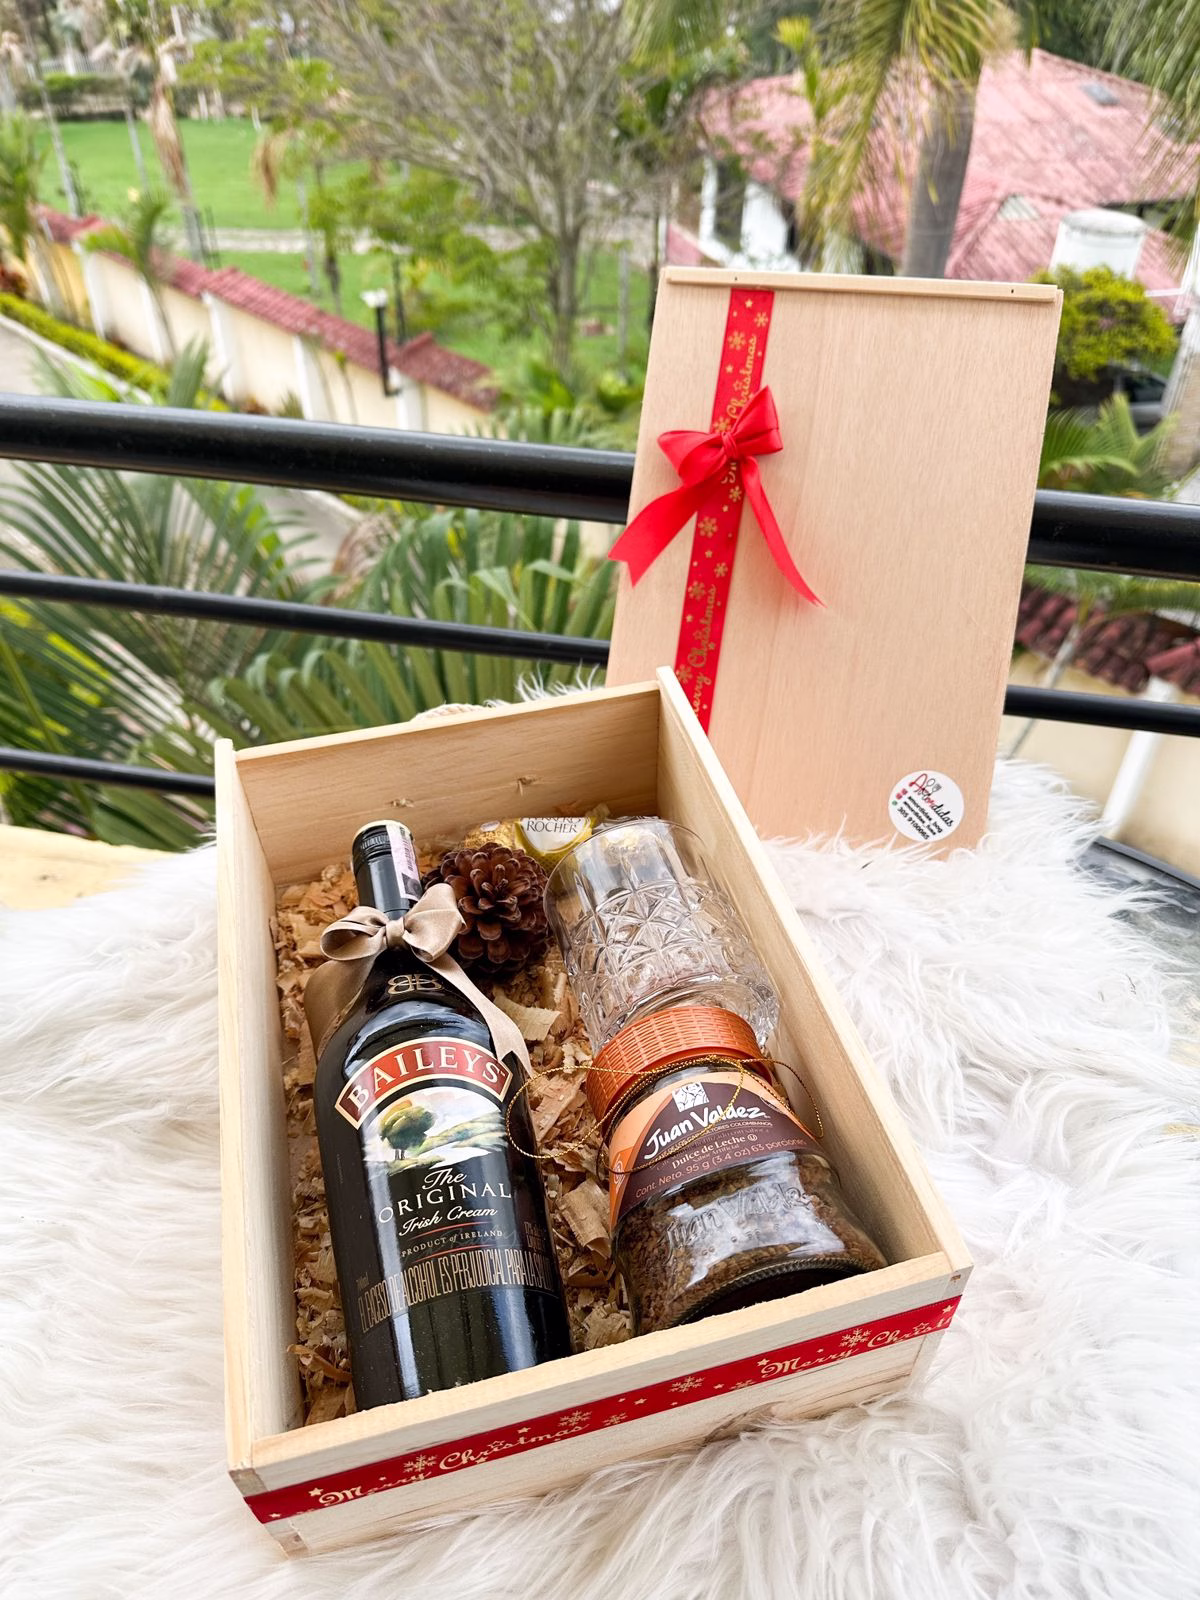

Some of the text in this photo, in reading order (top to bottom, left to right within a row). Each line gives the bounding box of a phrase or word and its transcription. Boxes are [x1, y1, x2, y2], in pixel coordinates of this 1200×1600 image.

[692, 672, 712, 716] erry
[527, 820, 577, 833] ROCHER
[347, 1046, 500, 1112] BAILEYS
[644, 1119, 694, 1160] Juan
[690, 1105, 766, 1128] Valdez
[672, 1150, 700, 1169] Dulce
[701, 1143, 714, 1154] de
[715, 1135, 746, 1149] Leche
[422, 1168, 467, 1190] The
[636, 1183, 657, 1198] Cont.
[659, 1171, 684, 1187] Neto.
[686, 1163, 699, 1174] 95
[702, 1161, 710, 1170] g
[734, 1147, 751, 1158] oz)
[751, 1142, 765, 1152] 63
[379, 1183, 512, 1223] ORIGINAL
[399, 1206, 498, 1236] Irish Cream
[402, 1230, 503, 1258] PRODUCT of IRELAND
[401, 1260, 441, 1307] ALCOHOL
[438, 1256, 454, 1294] ES
[450, 1249, 508, 1292] PERJUDICIAL
[504, 1248, 526, 1286] PARA
[761, 1348, 859, 1378] Merry
[319, 1423, 590, 1506] Merry Christmas
